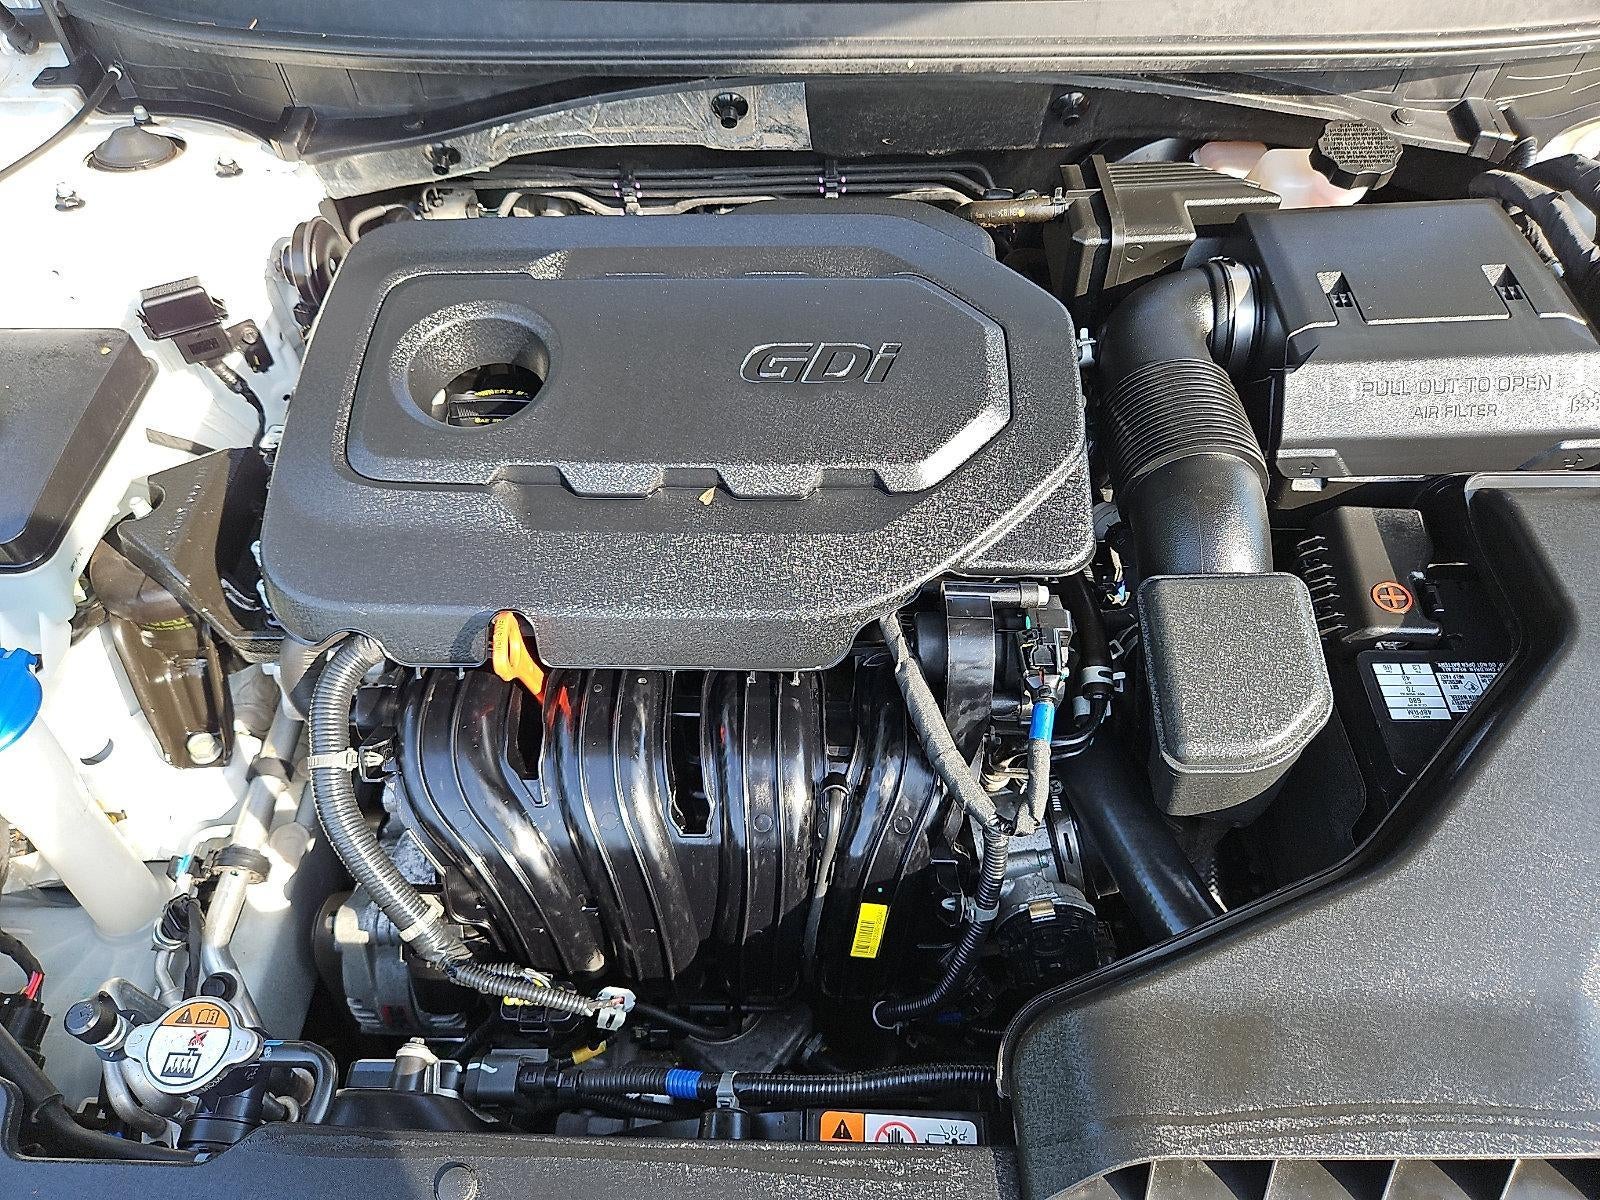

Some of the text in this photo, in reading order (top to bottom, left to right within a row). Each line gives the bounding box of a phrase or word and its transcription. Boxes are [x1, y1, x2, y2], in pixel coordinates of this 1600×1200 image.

[739, 342, 902, 384] GDi
[1361, 374, 1552, 397] PULL OUT TO OPEN
[1412, 403, 1499, 420] AIR FILTER
